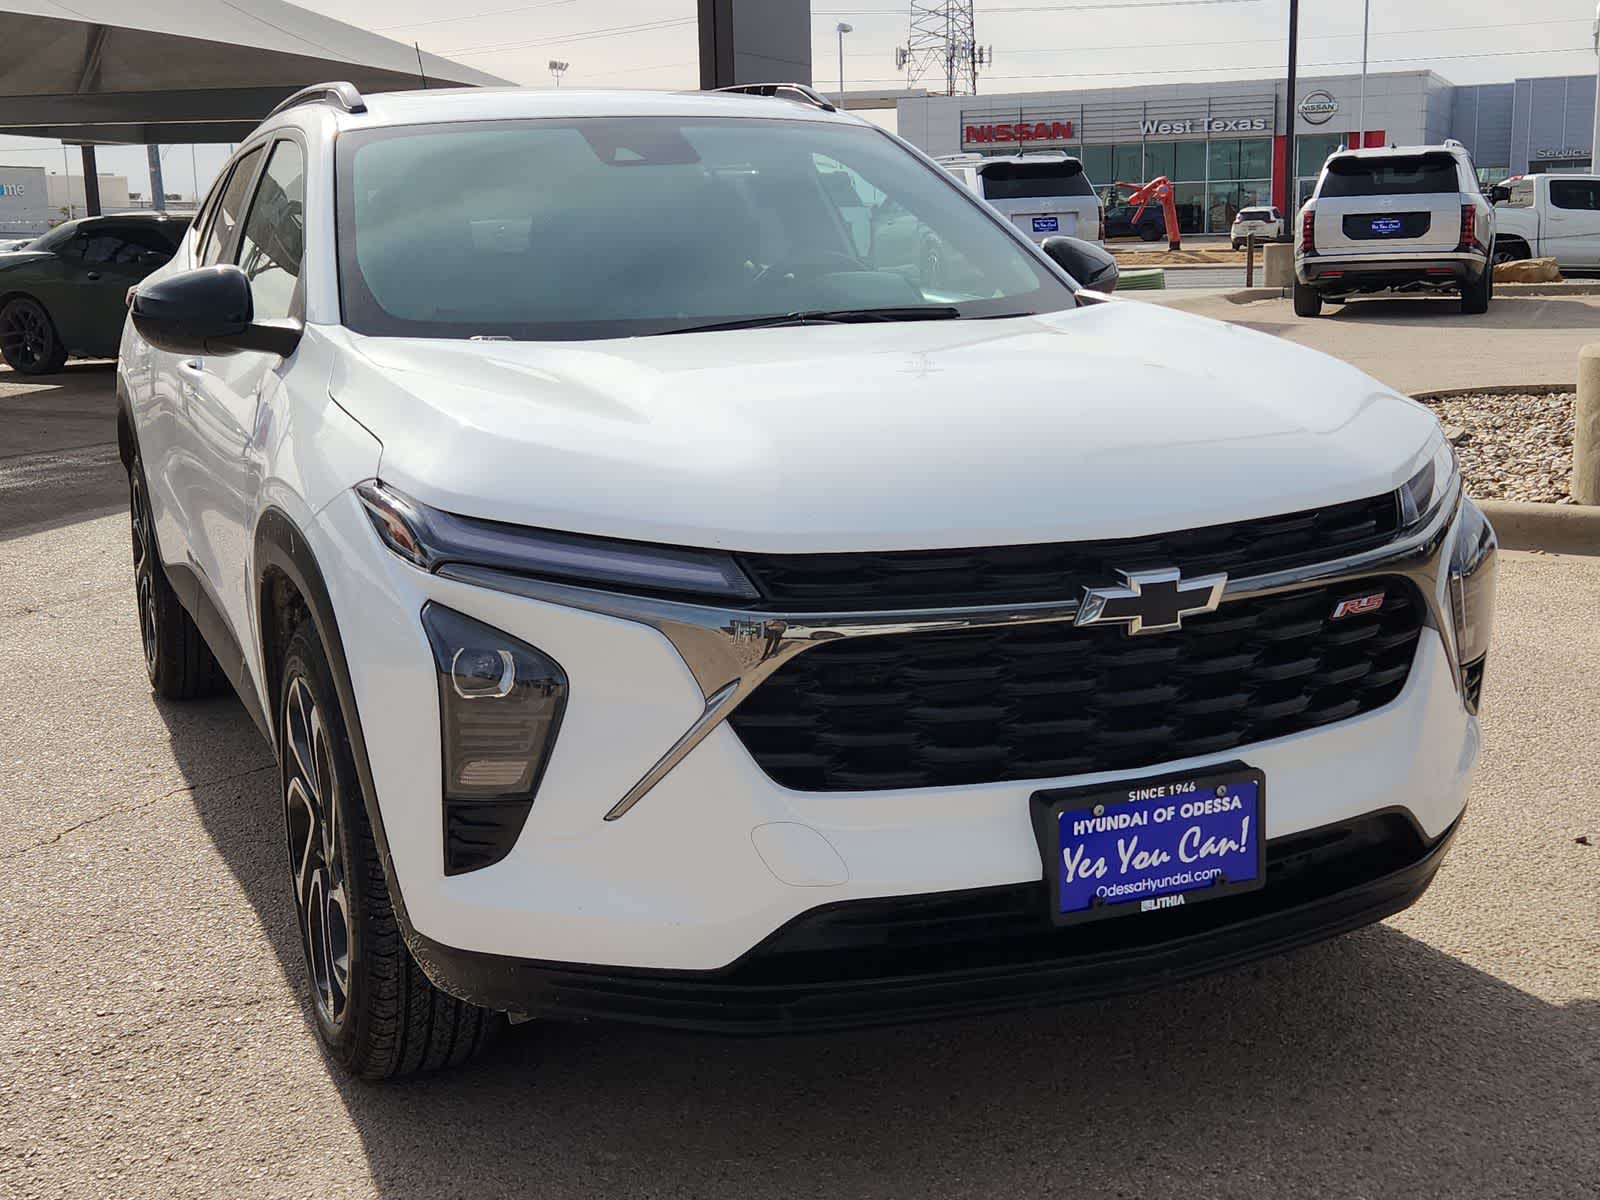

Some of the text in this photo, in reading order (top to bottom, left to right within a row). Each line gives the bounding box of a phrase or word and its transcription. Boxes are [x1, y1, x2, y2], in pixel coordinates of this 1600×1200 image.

[1302, 103, 1334, 111] NISSAN
[965, 121, 1073, 143] NISSAN
[1138, 117, 1265, 136] West Texas
[1333, 593, 1385, 618] RS
[1128, 781, 1197, 802] SINCE 1946
[1073, 795, 1242, 836] HYUNDAI OF ODESSA
[1063, 815, 1250, 883] Yes You Can!
[1096, 867, 1222, 898] OdessaHyundai.com
[1151, 894, 1185, 911] LITHIA
